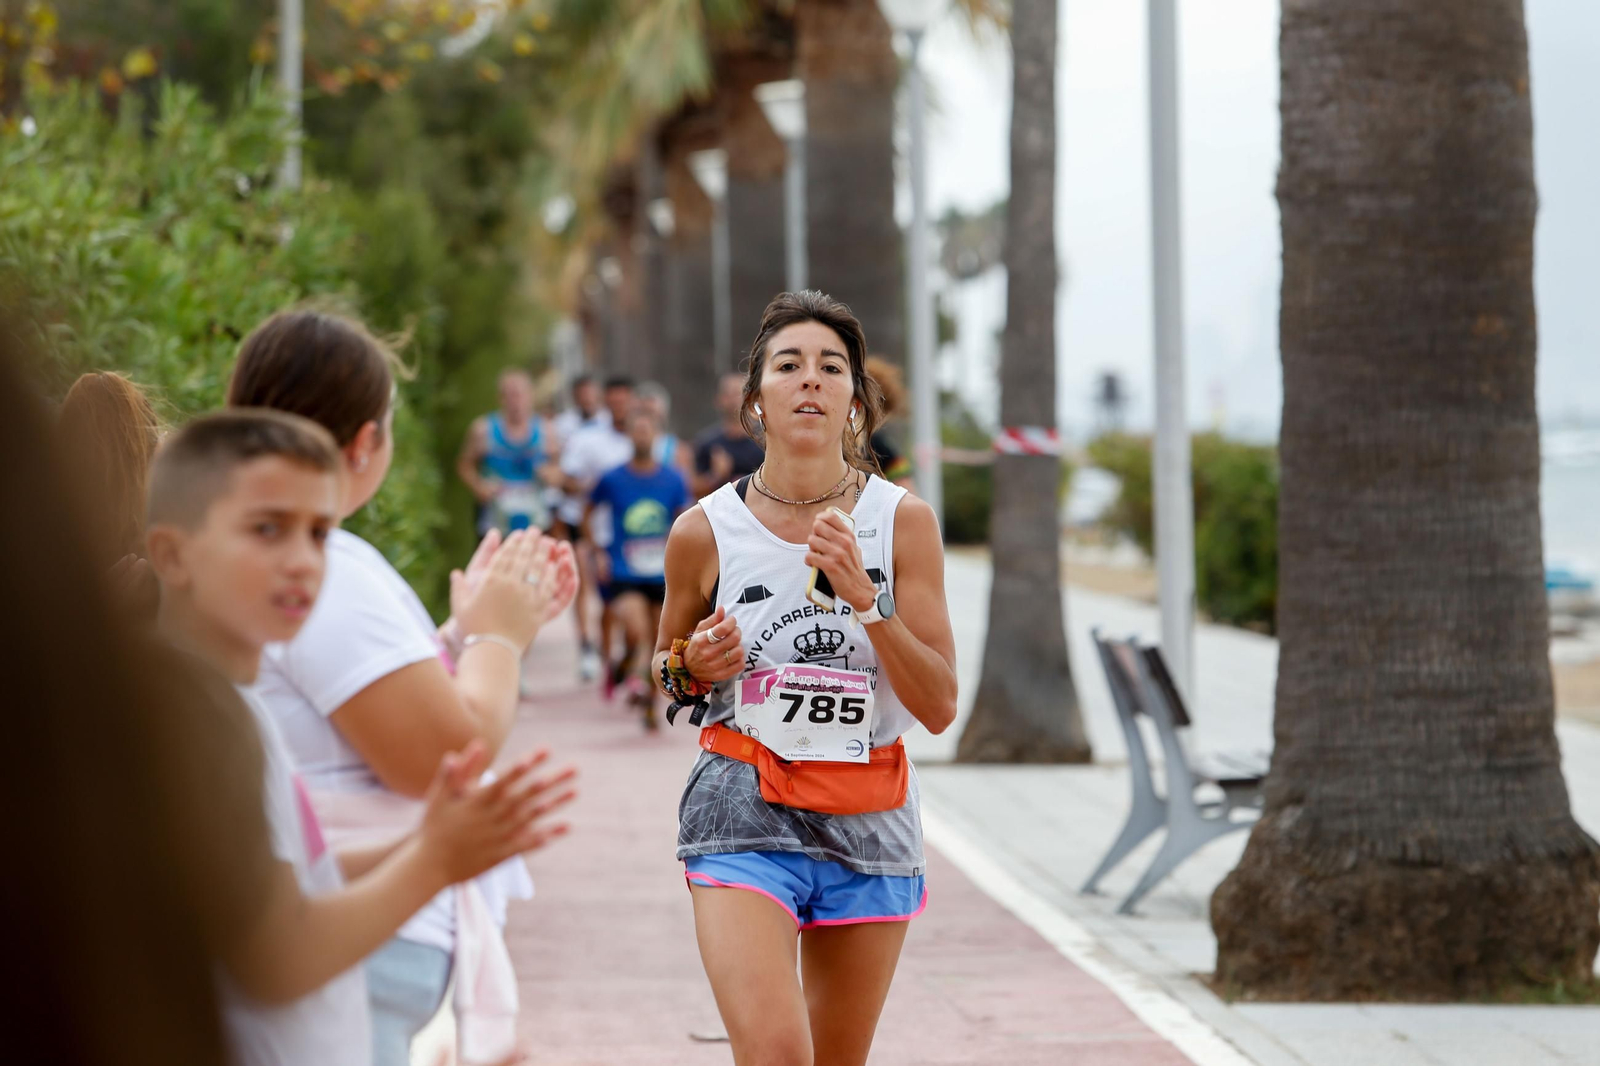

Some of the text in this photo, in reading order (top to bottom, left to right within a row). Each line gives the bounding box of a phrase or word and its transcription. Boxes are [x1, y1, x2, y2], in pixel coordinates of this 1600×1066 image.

[761, 605, 837, 642] CARRERA
[840, 605, 852, 616] P
[779, 693, 866, 725] 785
